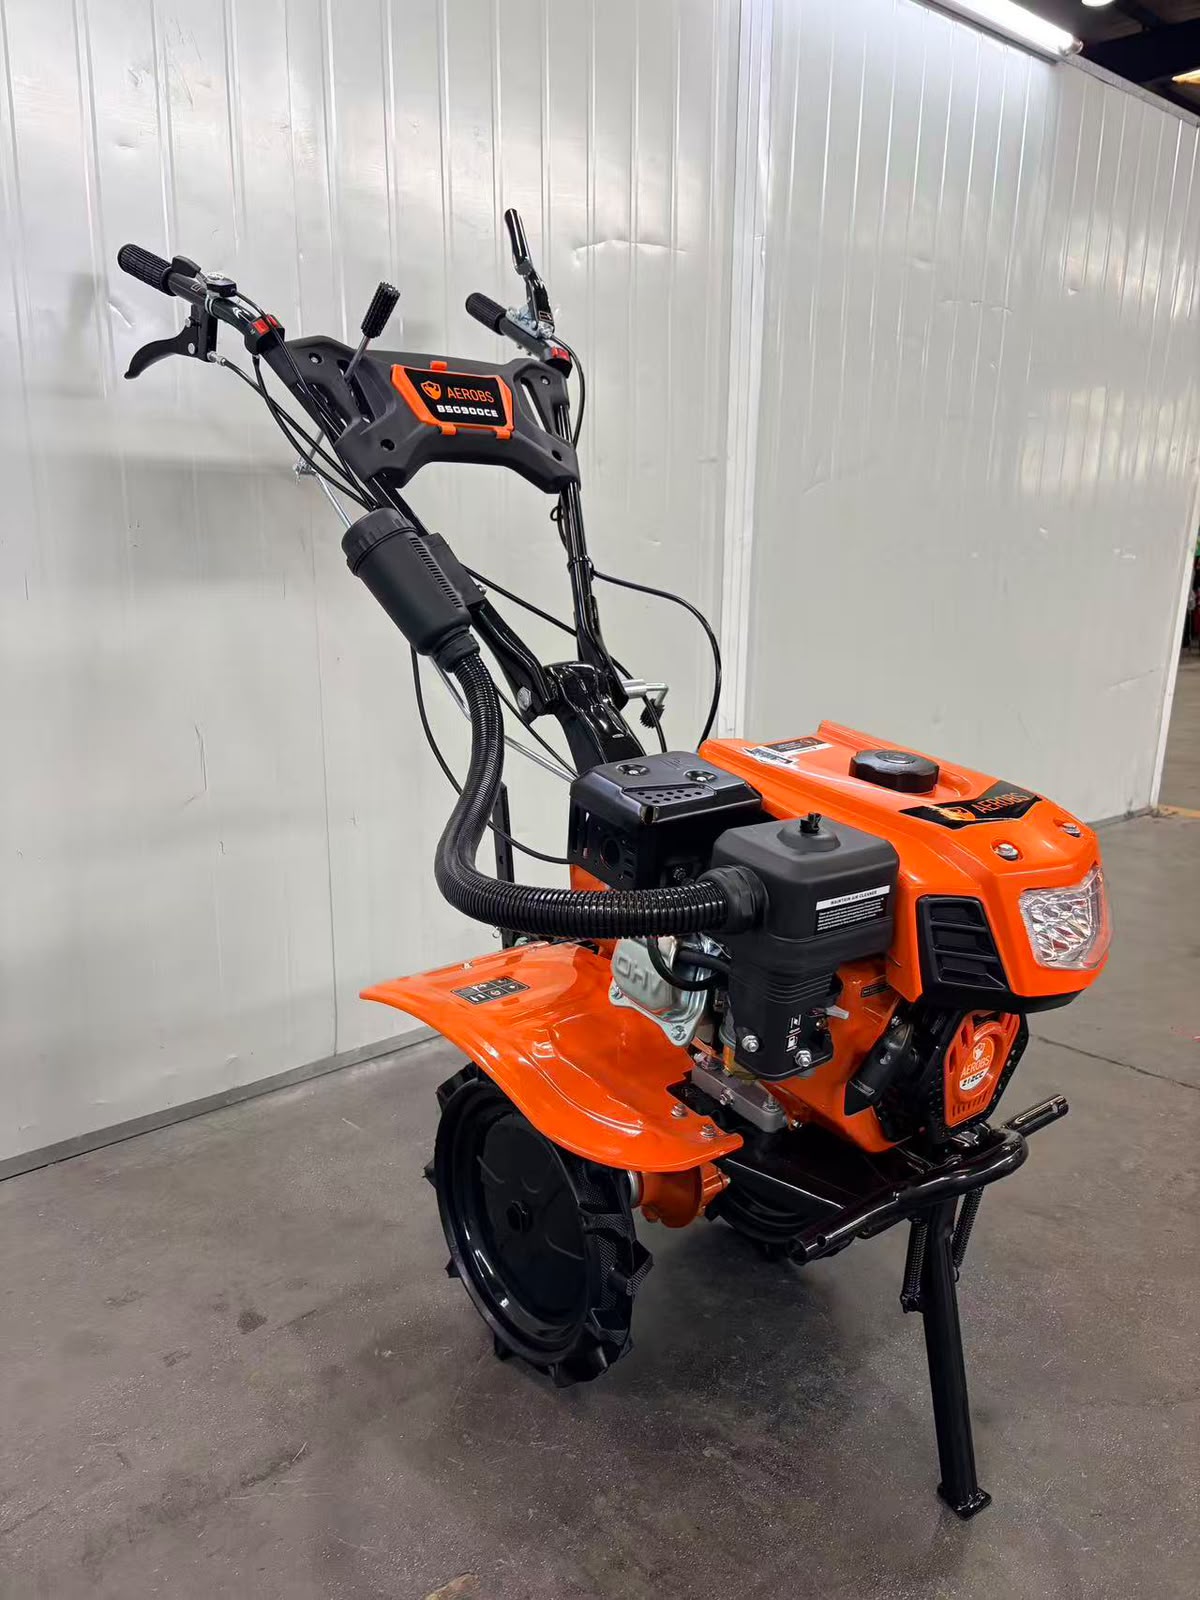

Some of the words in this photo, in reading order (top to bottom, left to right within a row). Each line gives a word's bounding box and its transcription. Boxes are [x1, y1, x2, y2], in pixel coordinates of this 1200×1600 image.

[447, 386, 495, 403] AEROBS
[971, 792, 1031, 814] AEROBS
[615, 955, 664, 996] OHV
[960, 1055, 991, 1080] AEROBS
